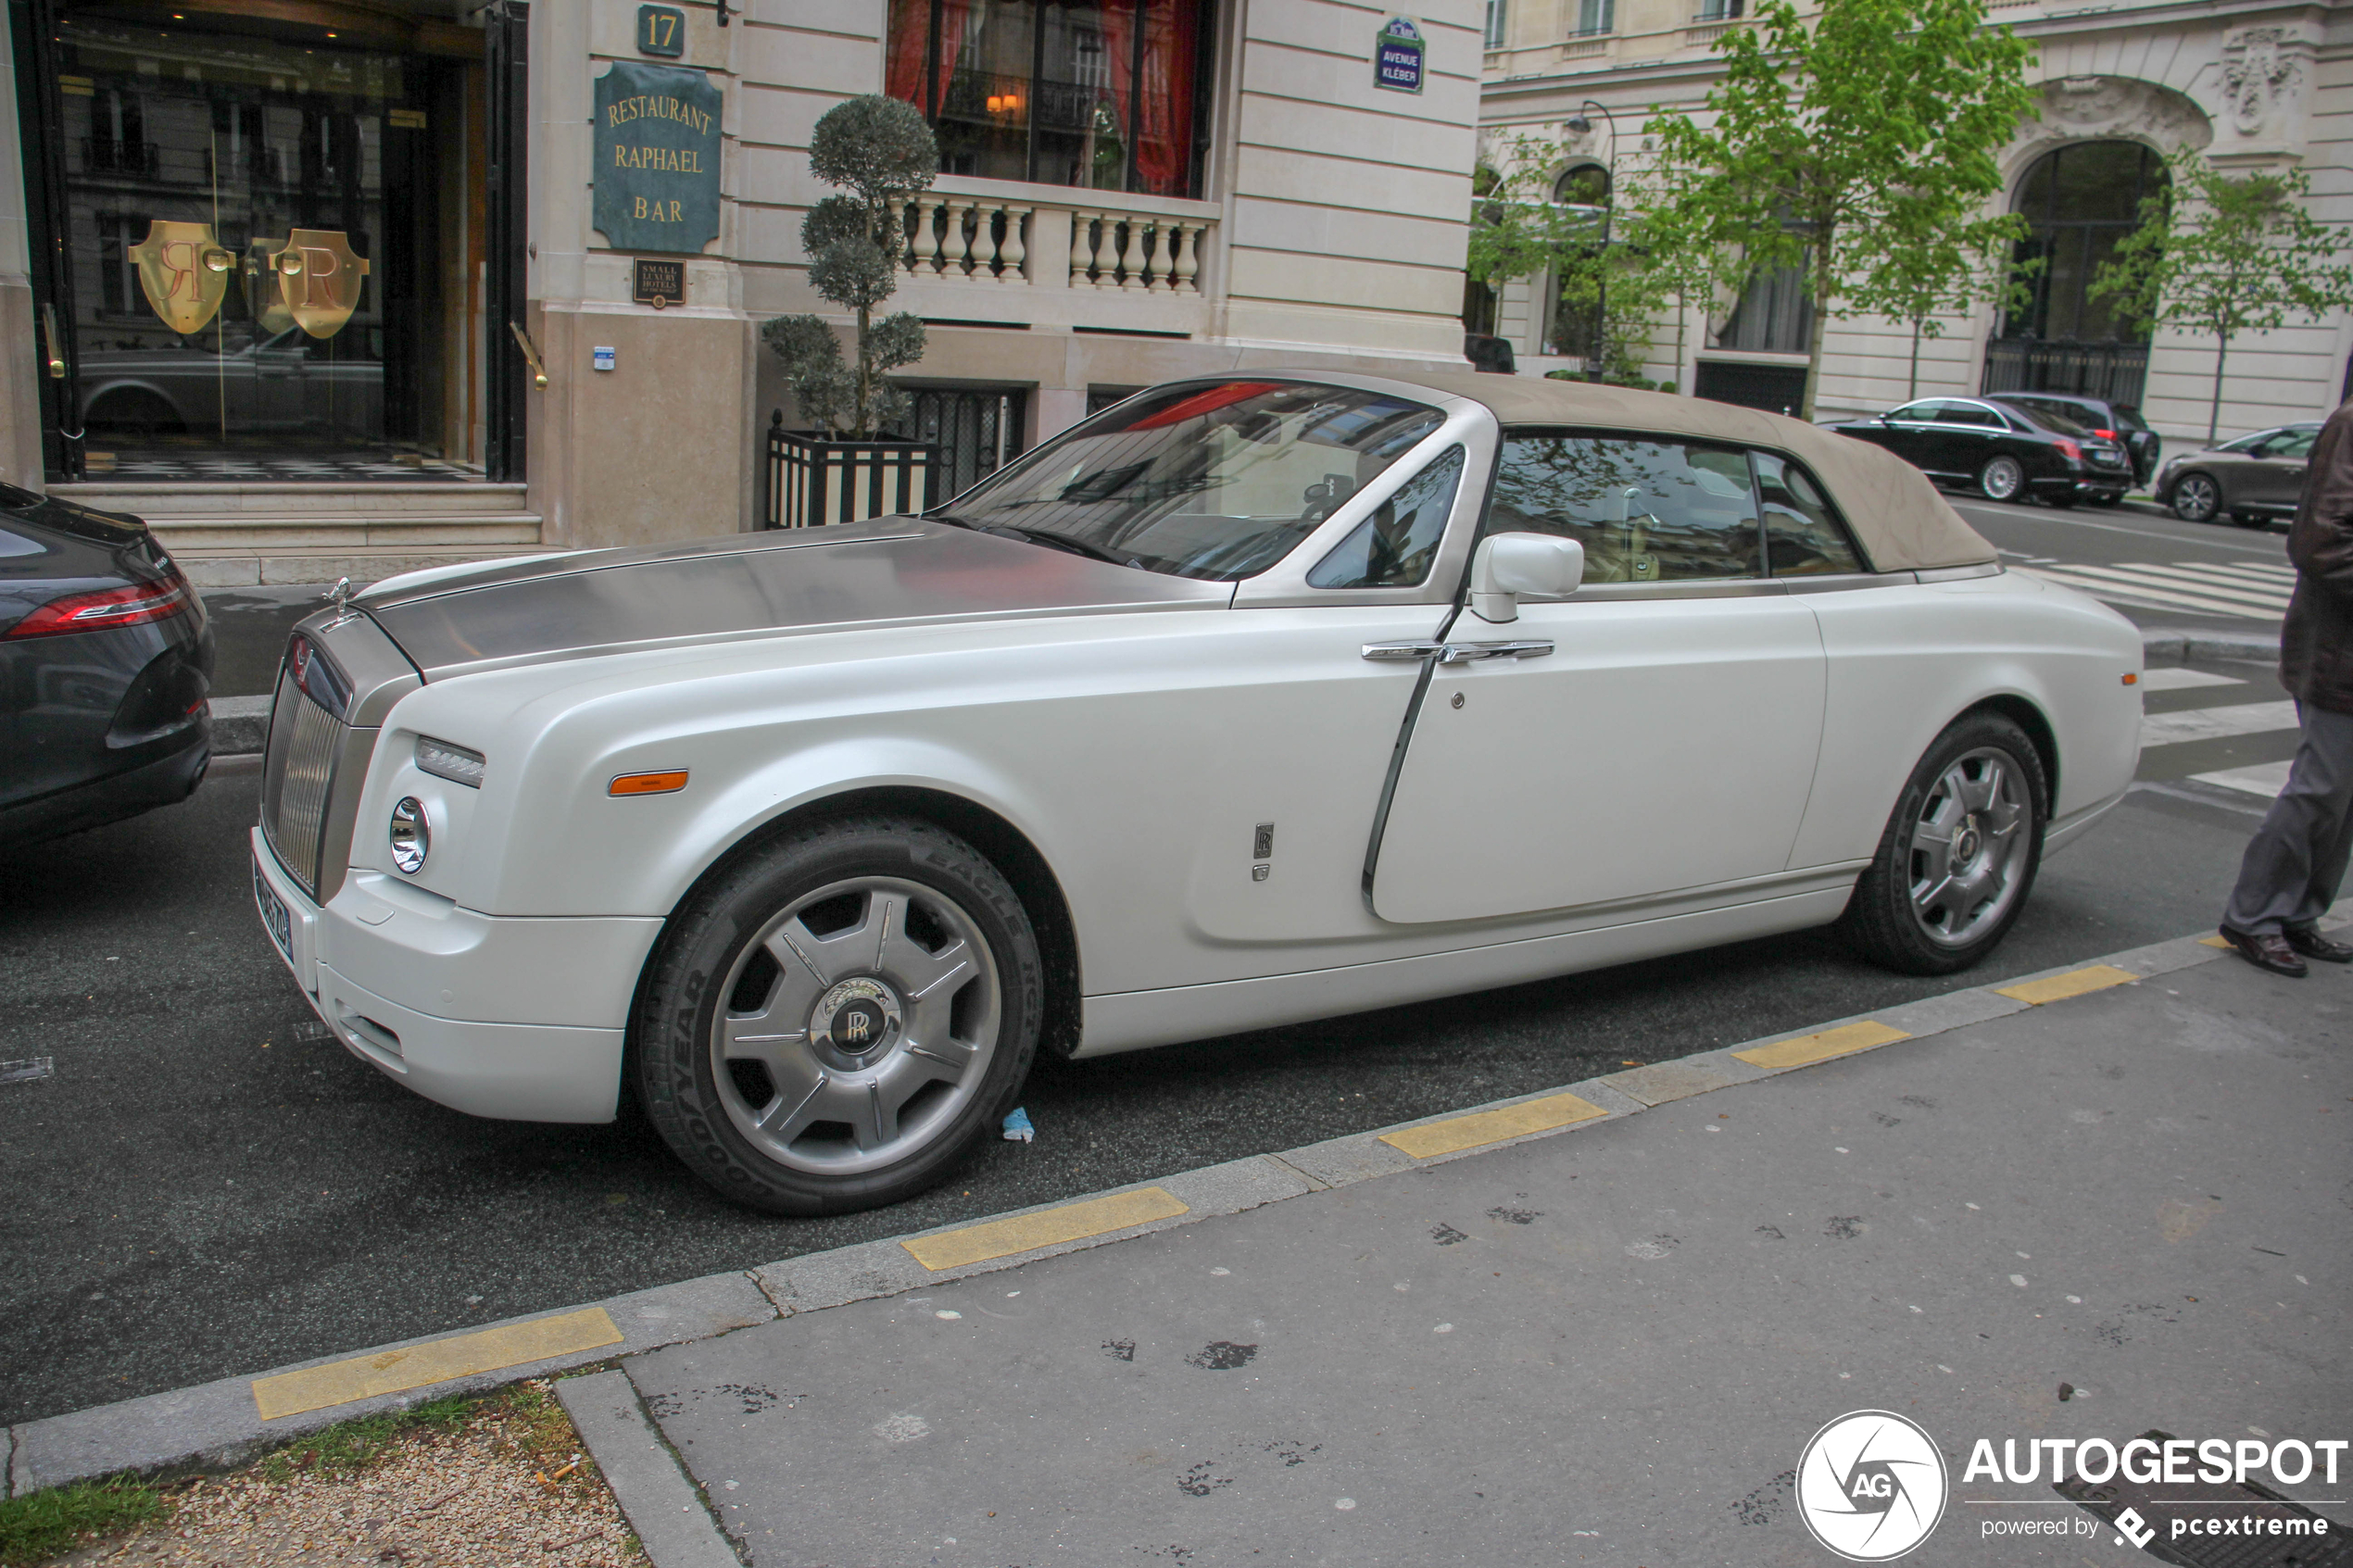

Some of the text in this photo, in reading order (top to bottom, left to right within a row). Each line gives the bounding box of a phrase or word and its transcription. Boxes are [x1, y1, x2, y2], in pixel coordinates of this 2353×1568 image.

[648, 14, 677, 46] 17
[1383, 51, 1418, 67] AVENUE
[1382, 67, 1416, 82] KLÉBER
[608, 95, 711, 135] RESTAURANT
[615, 144, 703, 173] RAPHAEL
[634, 196, 684, 222] BAR
[297, 245, 346, 310] R
[642, 265, 677, 274] SMALL
[643, 273, 676, 282] LUXURY
[643, 281, 676, 289] HOTELS
[926, 851, 1025, 938] EAGLE
